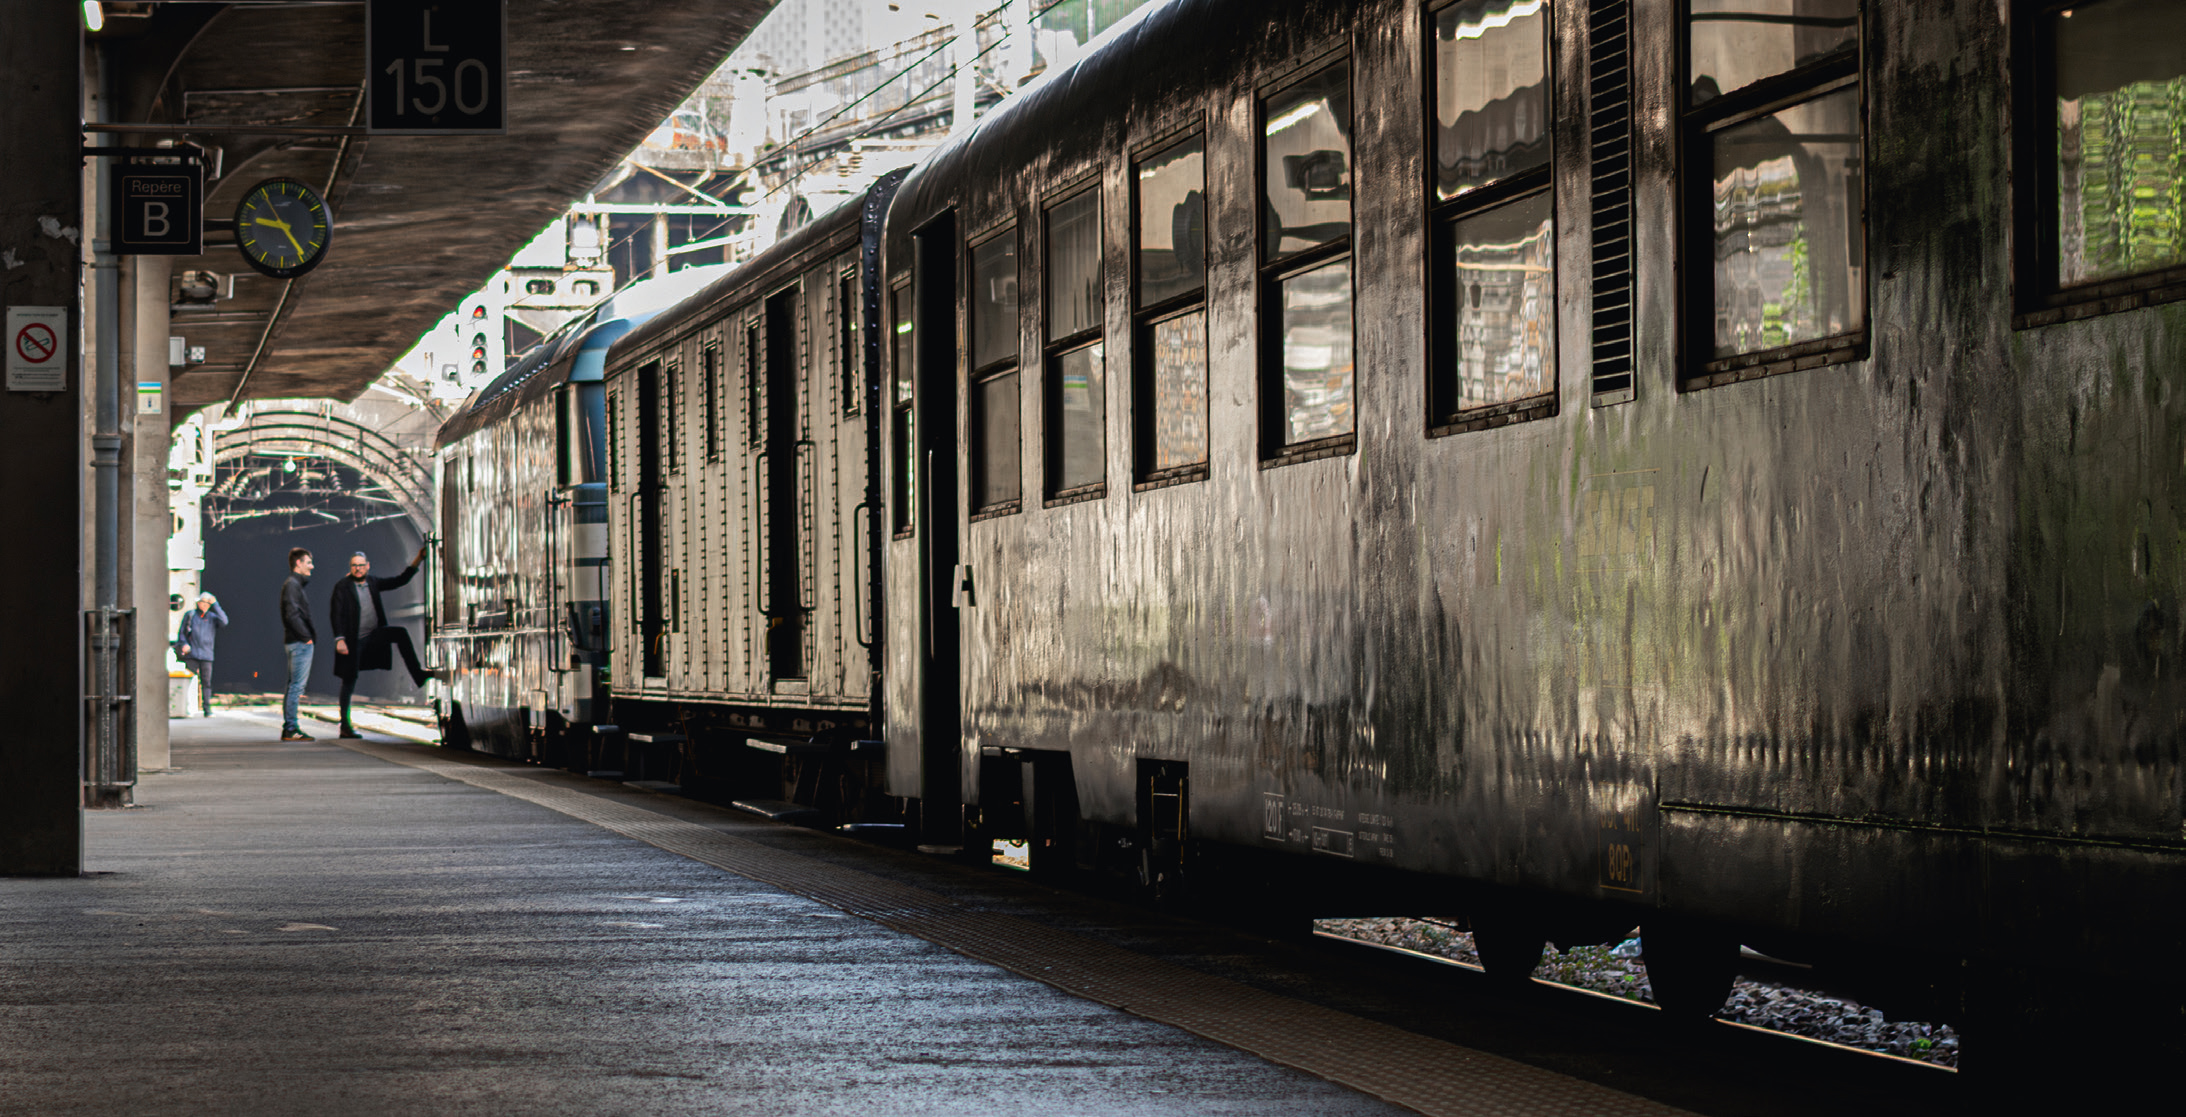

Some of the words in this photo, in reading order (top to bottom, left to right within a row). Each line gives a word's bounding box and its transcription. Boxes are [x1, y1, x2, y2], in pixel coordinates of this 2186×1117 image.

[424, 9, 450, 52] L
[385, 58, 489, 115] 150
[132, 180, 182, 194] Repère
[143, 202, 171, 236] B
[1578, 485, 1655, 556] SNCF
